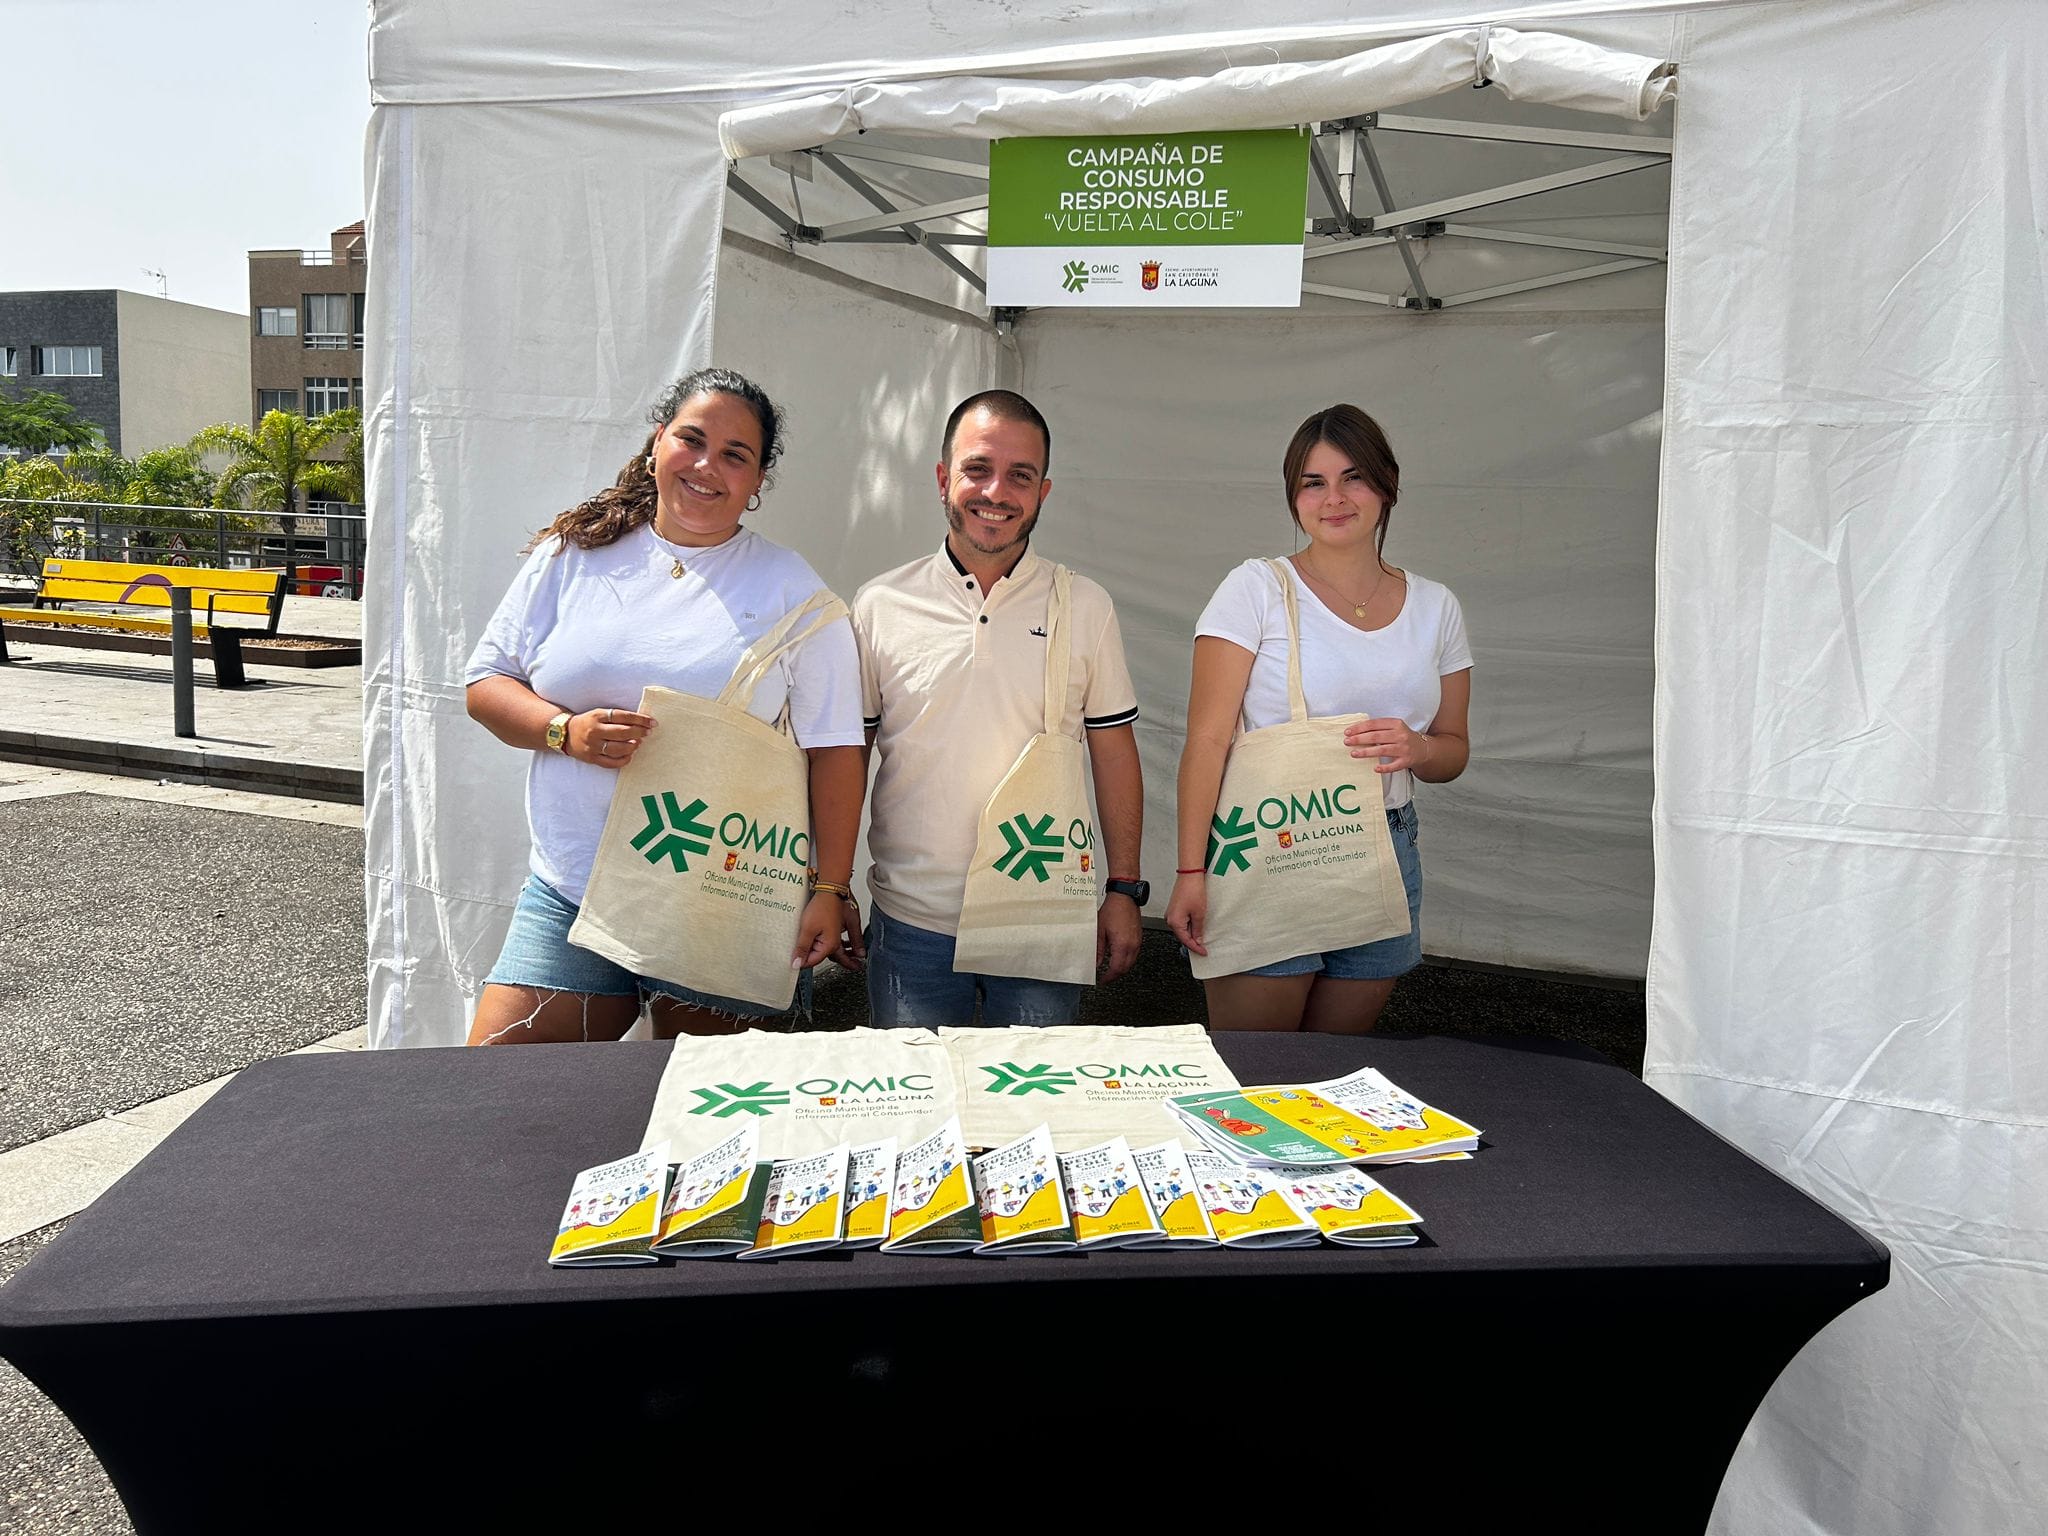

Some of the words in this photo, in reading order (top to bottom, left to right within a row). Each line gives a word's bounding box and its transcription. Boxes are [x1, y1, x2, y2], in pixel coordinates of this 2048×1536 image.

[1067, 142, 1184, 167] CAMPAÑA
[1191, 145, 1224, 165] DE
[1084, 168, 1205, 188] CONSUMO
[1060, 189, 1228, 210] RESPONSABLE
[1139, 212, 1168, 231] AL
[1091, 264, 1120, 274] OMIC
[1164, 278, 1176, 287] LA
[1179, 278, 1218, 287] LAGUNA
[1256, 784, 1361, 830] OMIC
[719, 812, 808, 867] OMIC
[1294, 832, 1310, 843] LA
[1312, 823, 1364, 839] LAGUNA
[1264, 853, 1291, 865] Oficina
[1292, 845, 1330, 859] Municipal
[1330, 842, 1340, 852] de
[1313, 857, 1320, 867] al
[1321, 850, 1367, 865] Consumidor
[736, 860, 749, 873] LA
[752, 864, 804, 886] LAGUNA
[1063, 874, 1086, 885] Oficina
[704, 870, 727, 884] Oficina
[727, 875, 763, 892] Municipal
[763, 885, 774, 895] de
[739, 893, 748, 902] al
[748, 893, 796, 913] Consumidor
[1076, 1064, 1208, 1079] OMIC
[795, 1074, 934, 1095] OMIC
[866, 1094, 934, 1104] LAGUNA
[834, 1104, 885, 1113] Municipal
[872, 1109, 934, 1118] Consumidor
[850, 1153, 875, 1161] LTA
[980, 1144, 1031, 1168] VUELTA
[999, 1150, 1032, 1166] COLE
[1075, 1157, 1110, 1169] COLE
[1137, 1154, 1162, 1162] LTA
[1139, 1159, 1165, 1168] OLE
